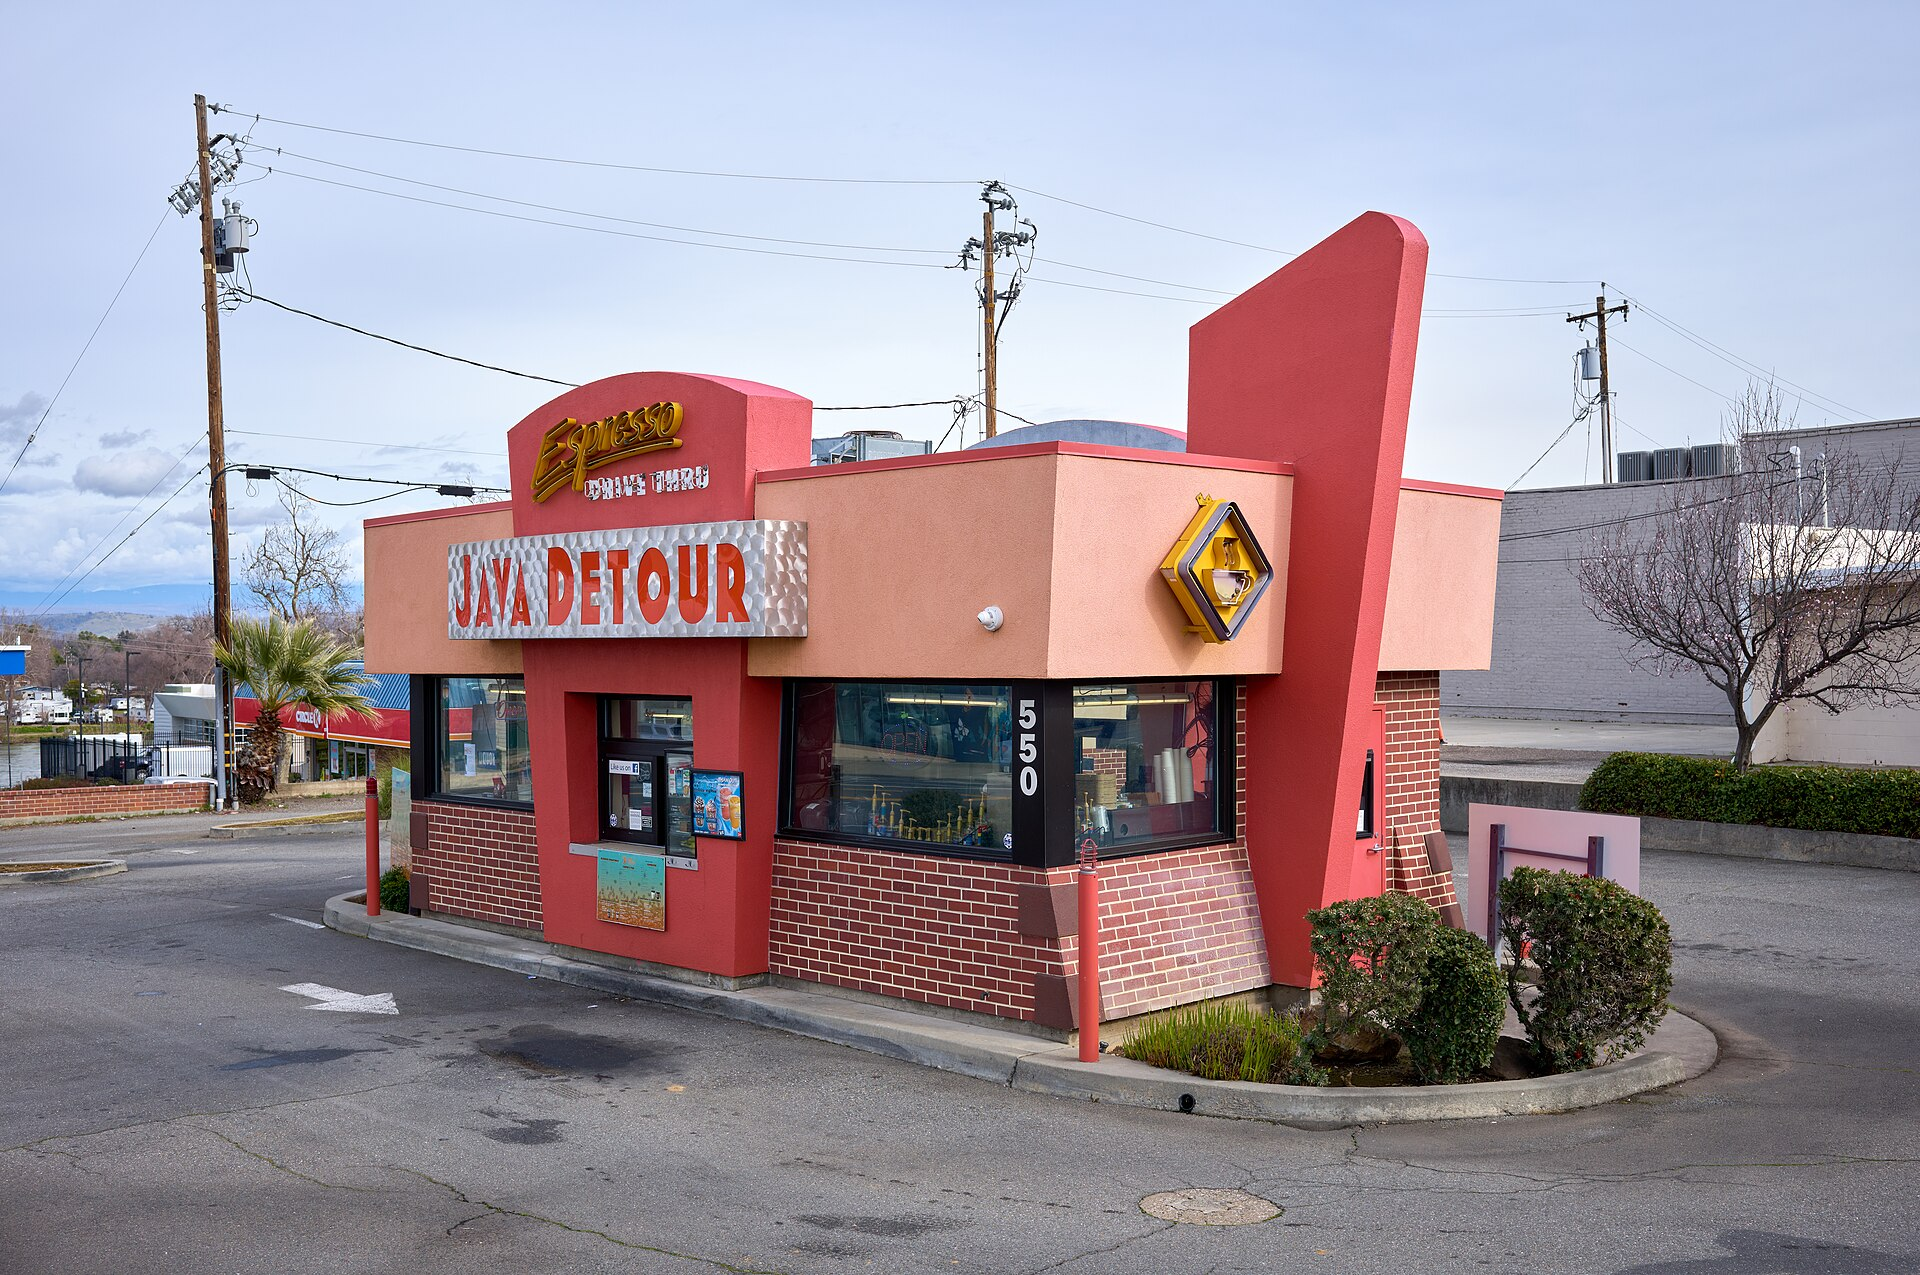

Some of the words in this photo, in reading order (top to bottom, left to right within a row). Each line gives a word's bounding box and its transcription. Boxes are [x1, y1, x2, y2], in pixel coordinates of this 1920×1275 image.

[531, 401, 684, 493] Espresso
[584, 473, 647, 501] DRIVE
[650, 464, 710, 494] THRU
[455, 554, 531, 628] JAVA
[547, 543, 751, 627] DETOUR
[296, 711, 313, 724] CIRCLE
[880, 731, 928, 757] OPEN
[1018, 699, 1038, 797] 550
[611, 763, 619, 771] Like
